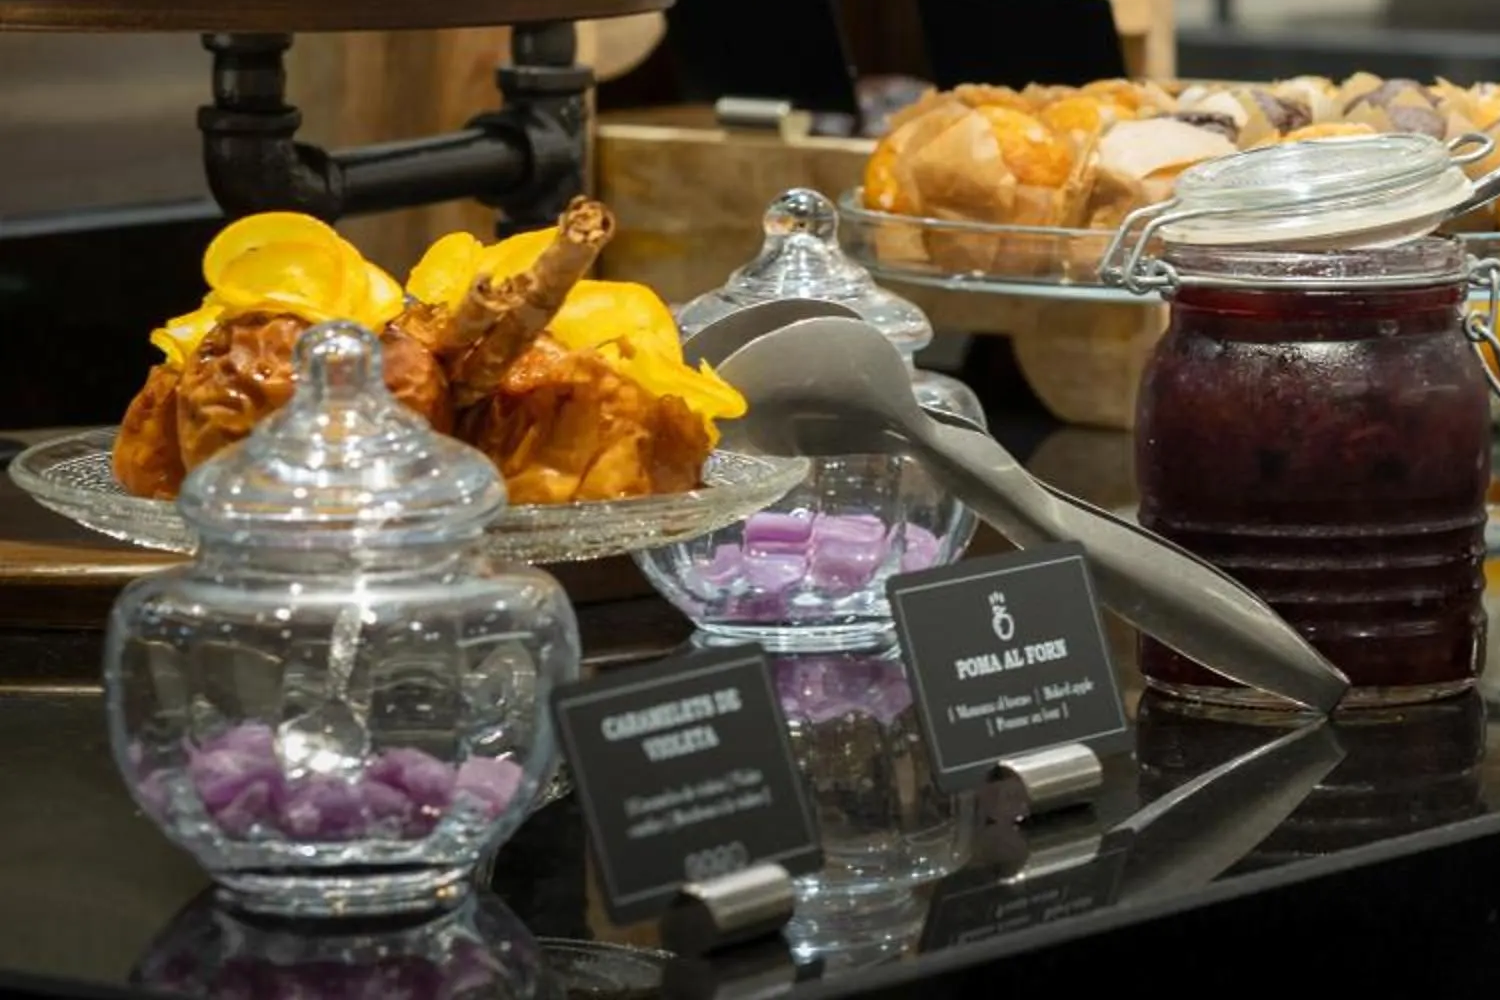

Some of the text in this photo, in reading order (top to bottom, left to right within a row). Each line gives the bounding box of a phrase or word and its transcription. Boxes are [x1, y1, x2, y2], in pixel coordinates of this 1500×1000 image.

[955, 638, 1068, 680] POMA AL FORN
